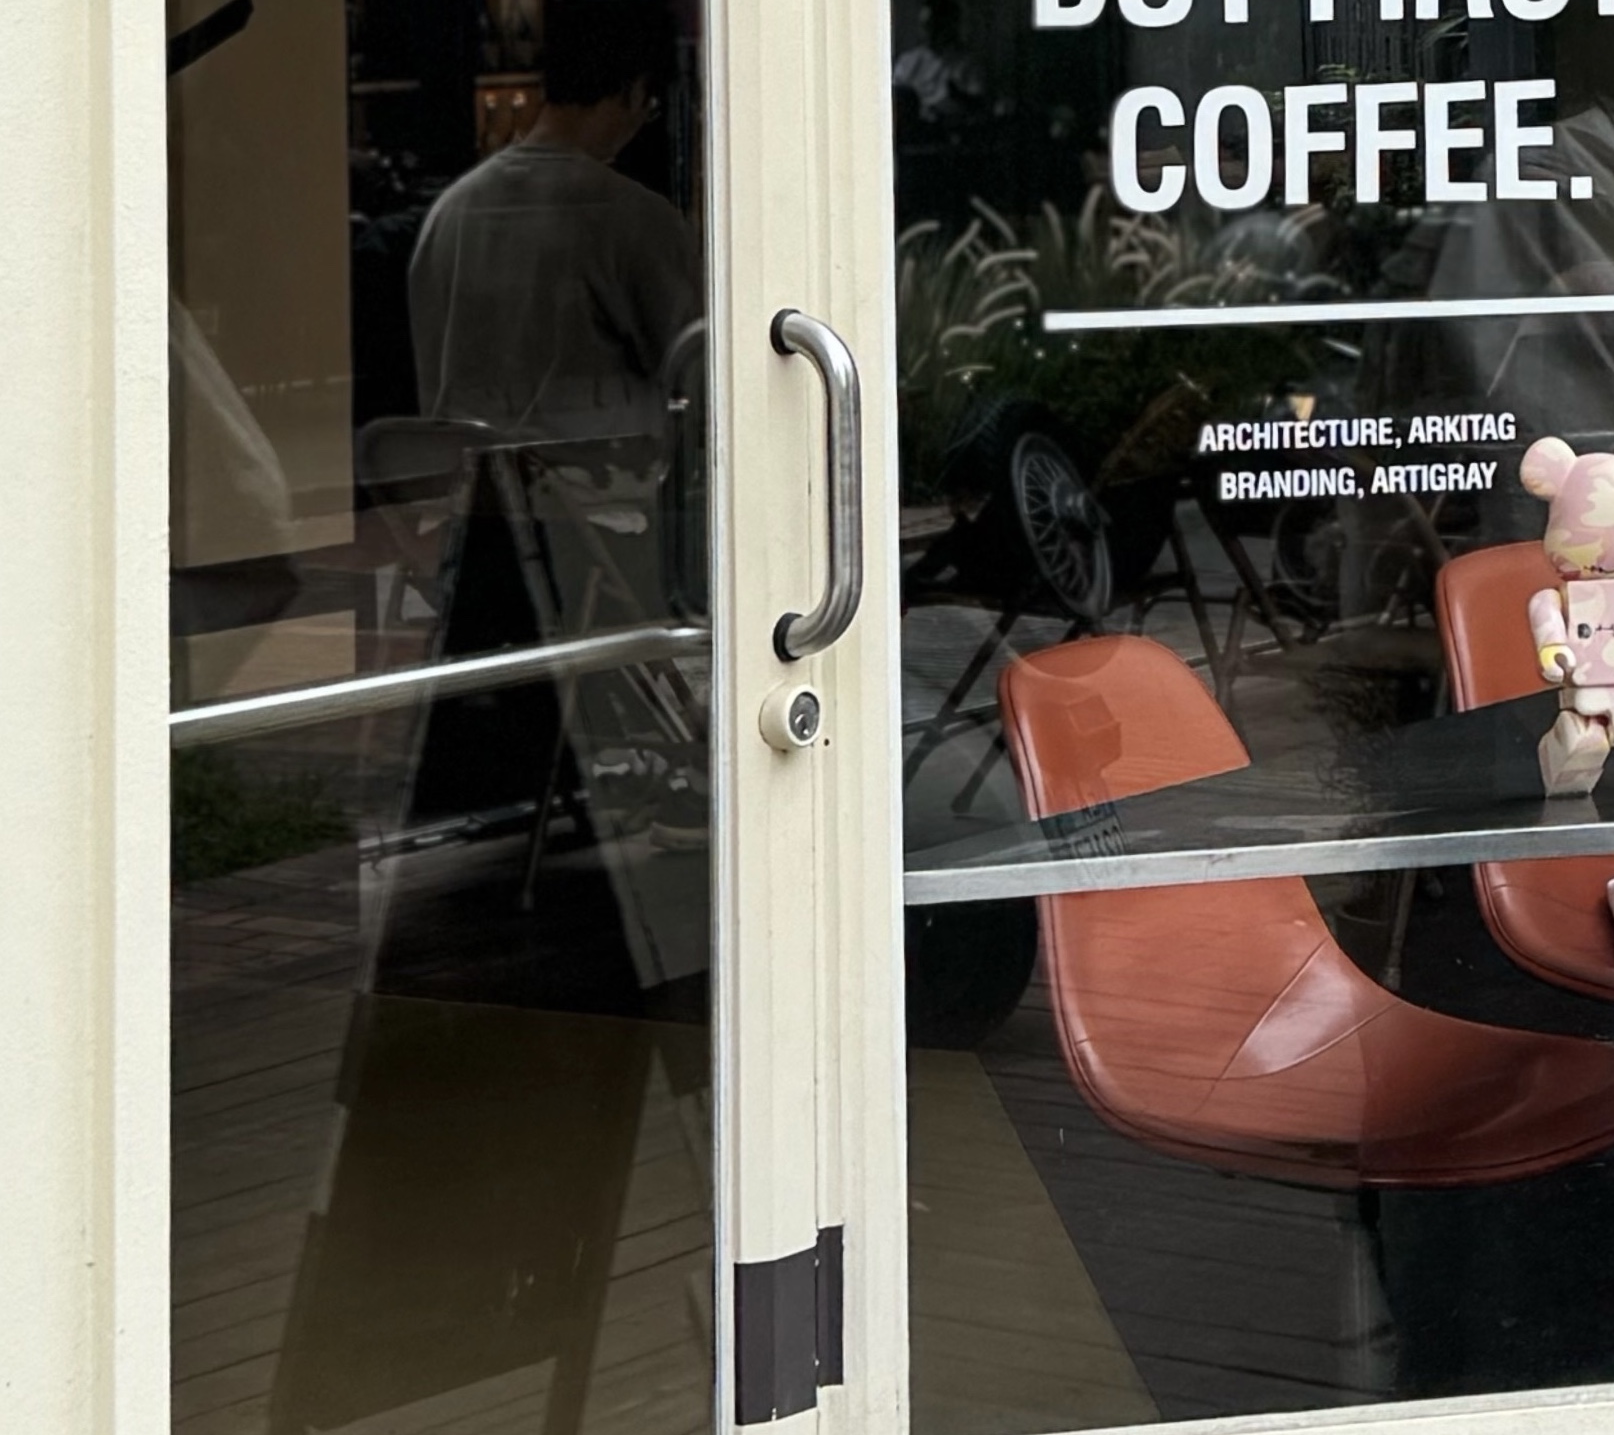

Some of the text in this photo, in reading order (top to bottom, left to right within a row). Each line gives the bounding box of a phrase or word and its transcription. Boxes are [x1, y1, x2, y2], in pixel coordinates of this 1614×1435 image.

[1110, 78, 1593, 212] COFFEE.
[1198, 412, 1517, 452] ARCHITECTURE, ARKITAG
[1220, 462, 1498, 501] BRANDING, ARTIGRAY
